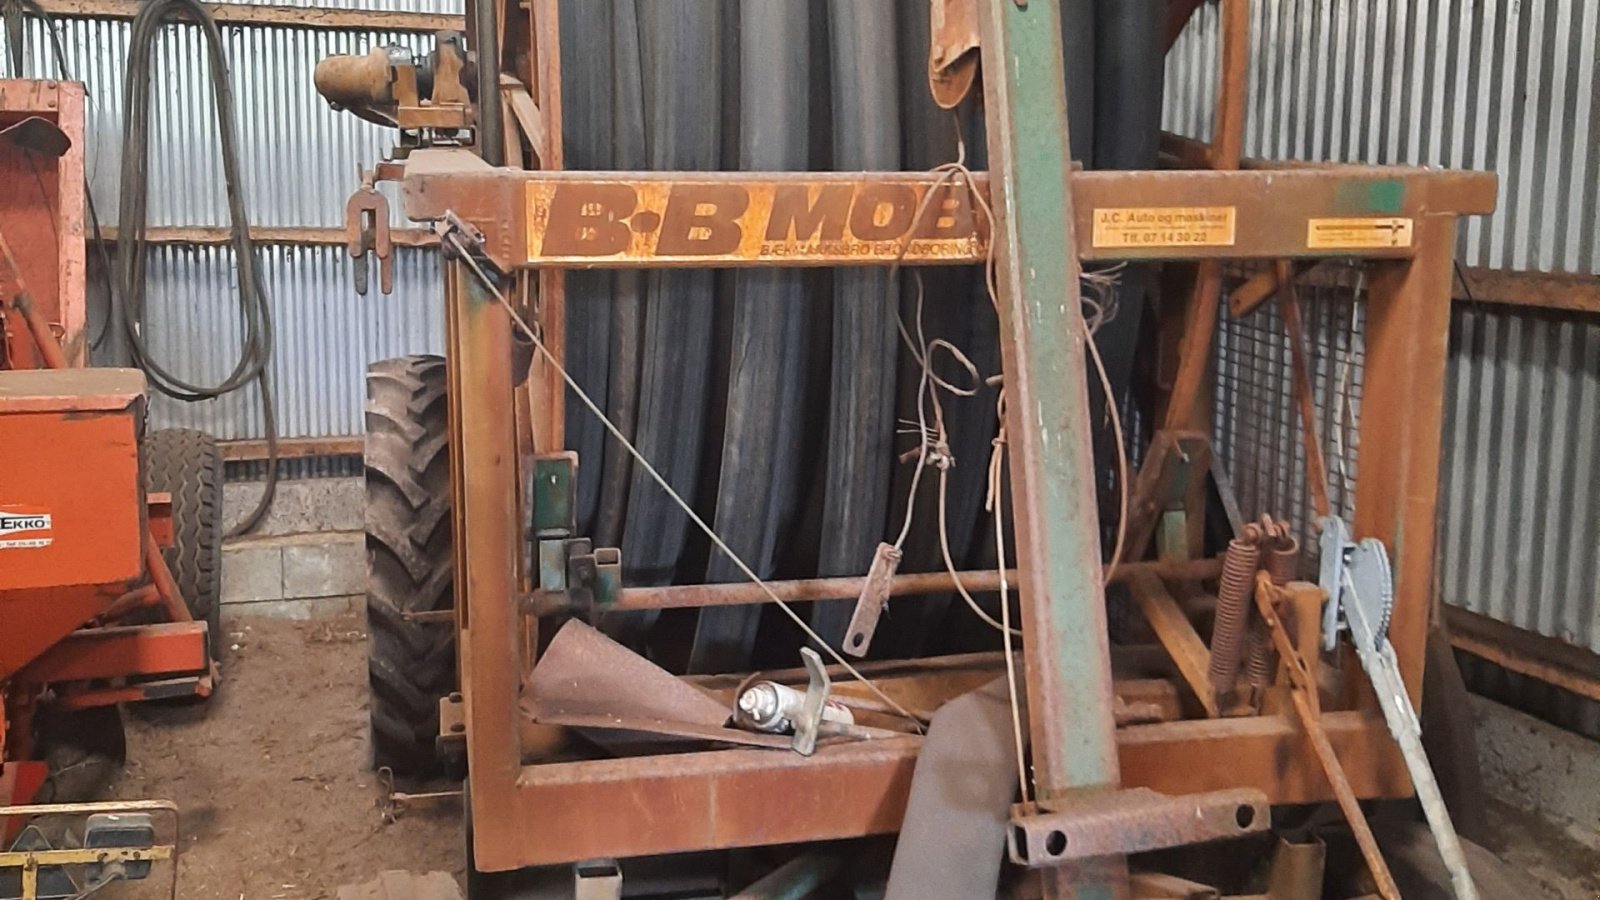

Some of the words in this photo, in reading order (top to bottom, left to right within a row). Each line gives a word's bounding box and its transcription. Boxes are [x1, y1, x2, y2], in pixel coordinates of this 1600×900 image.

[1127, 212, 1155, 223] Auto
[1157, 213, 1172, 224] og
[1143, 232, 1157, 243] 07
[1160, 232, 1174, 242] 14
